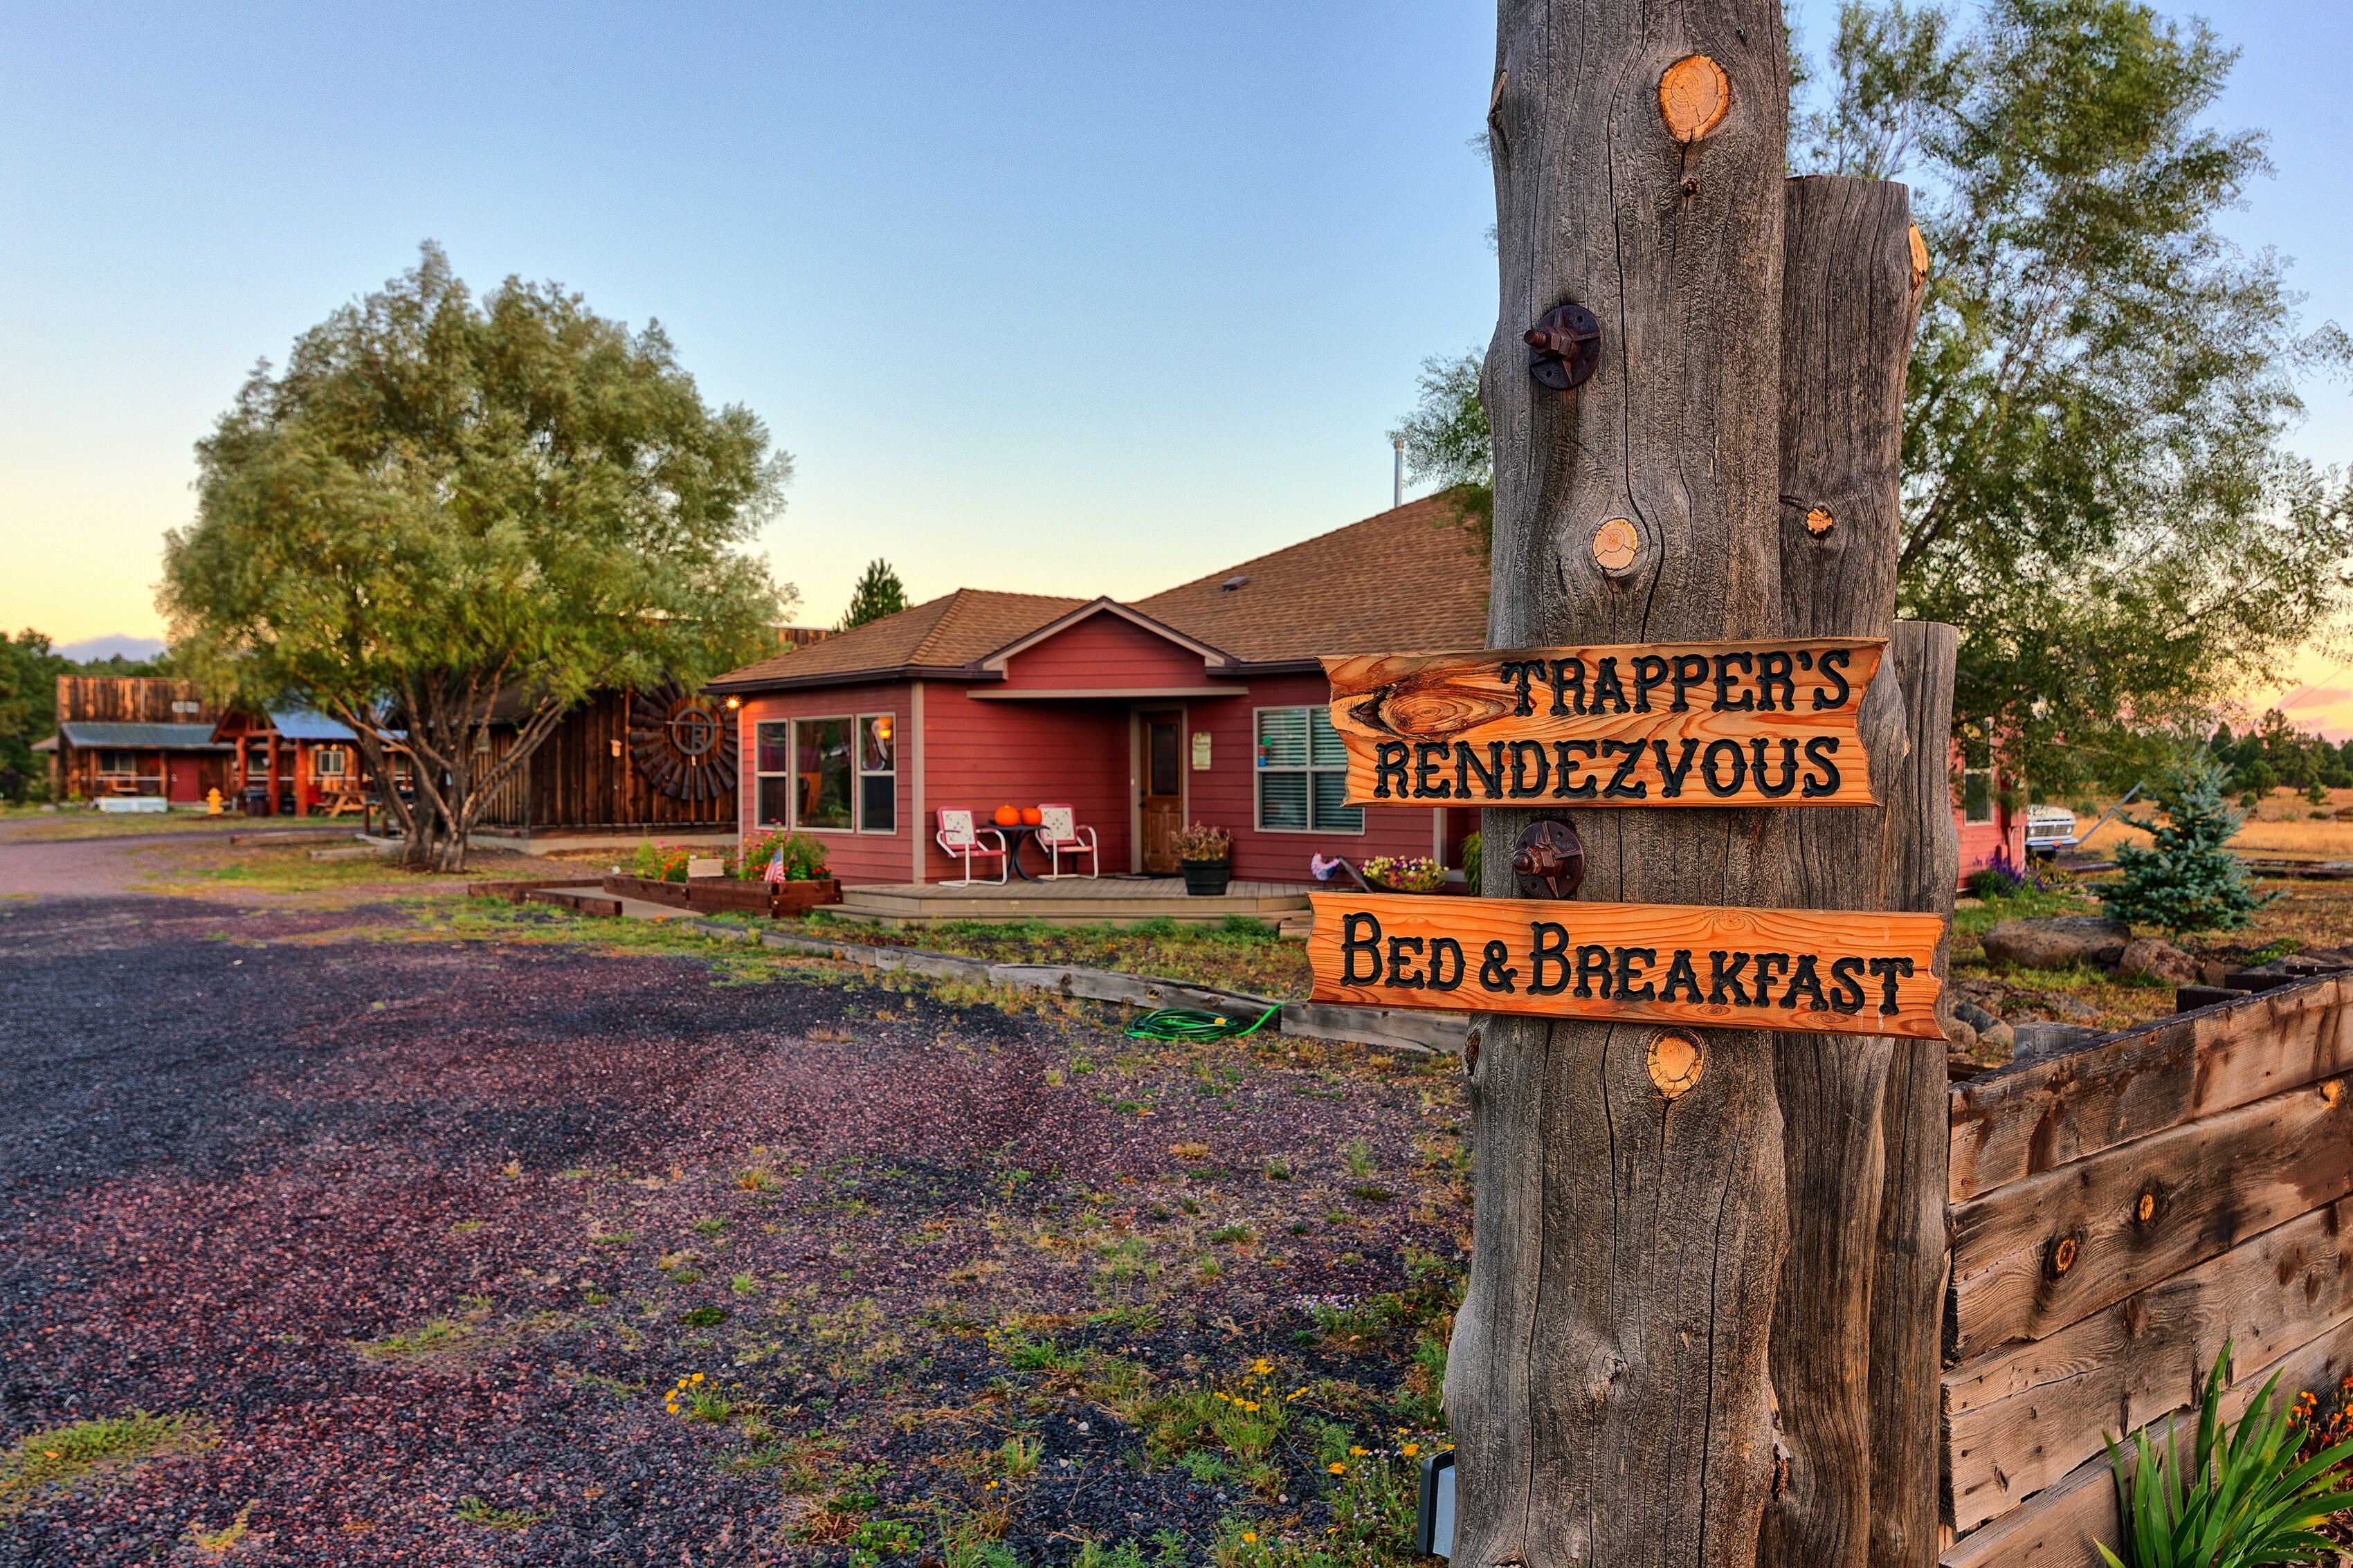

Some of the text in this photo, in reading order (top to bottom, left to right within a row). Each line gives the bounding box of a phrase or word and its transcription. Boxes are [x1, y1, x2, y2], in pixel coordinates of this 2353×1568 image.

[1500, 648, 1853, 717] TRAPPER'S
[1373, 736, 1841, 800] RENDEZVOUS
[1478, 940, 1516, 994] &
[1526, 921, 1914, 1016] BREAKFAST
